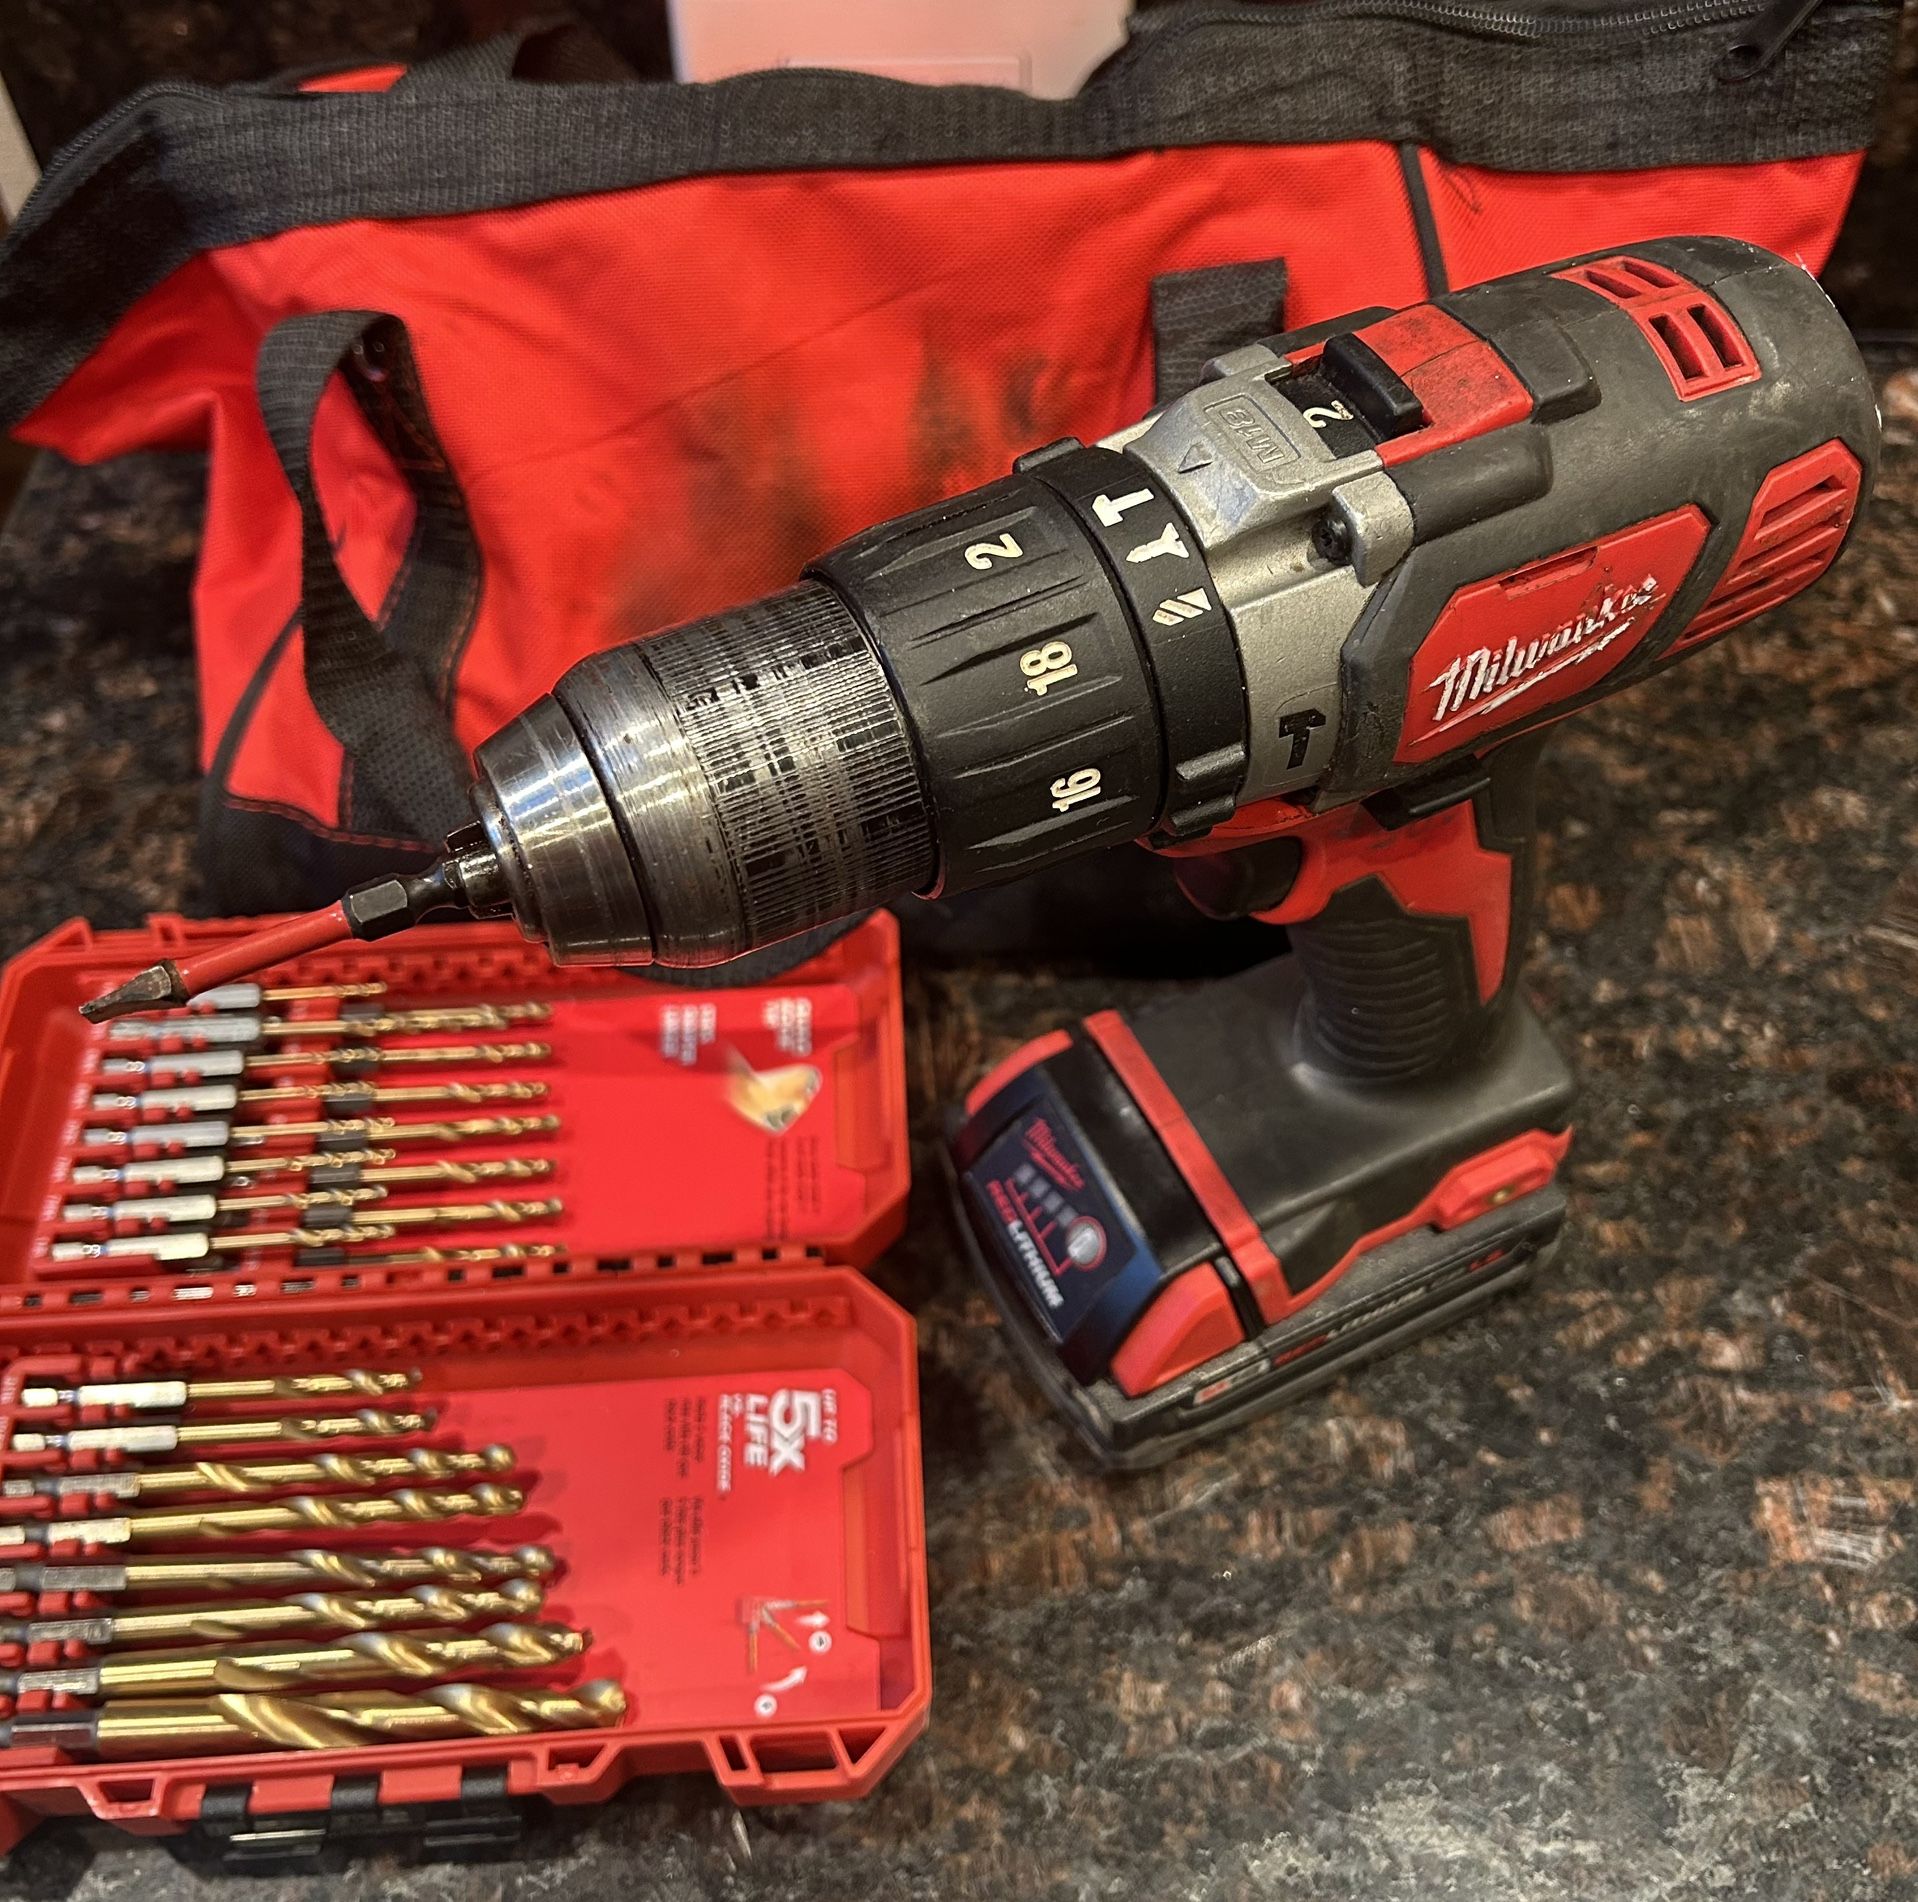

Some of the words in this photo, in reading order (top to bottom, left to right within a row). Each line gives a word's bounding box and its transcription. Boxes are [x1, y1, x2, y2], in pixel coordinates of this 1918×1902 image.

[1219, 405, 1285, 464] M18
[1303, 400, 1354, 428] 2
[964, 533, 1024, 570] 2
[1019, 641, 1078, 696] 18
[1050, 767, 1102, 812] 16
[744, 1393, 769, 1468] LIFE
[769, 1388, 821, 1477] 5X
